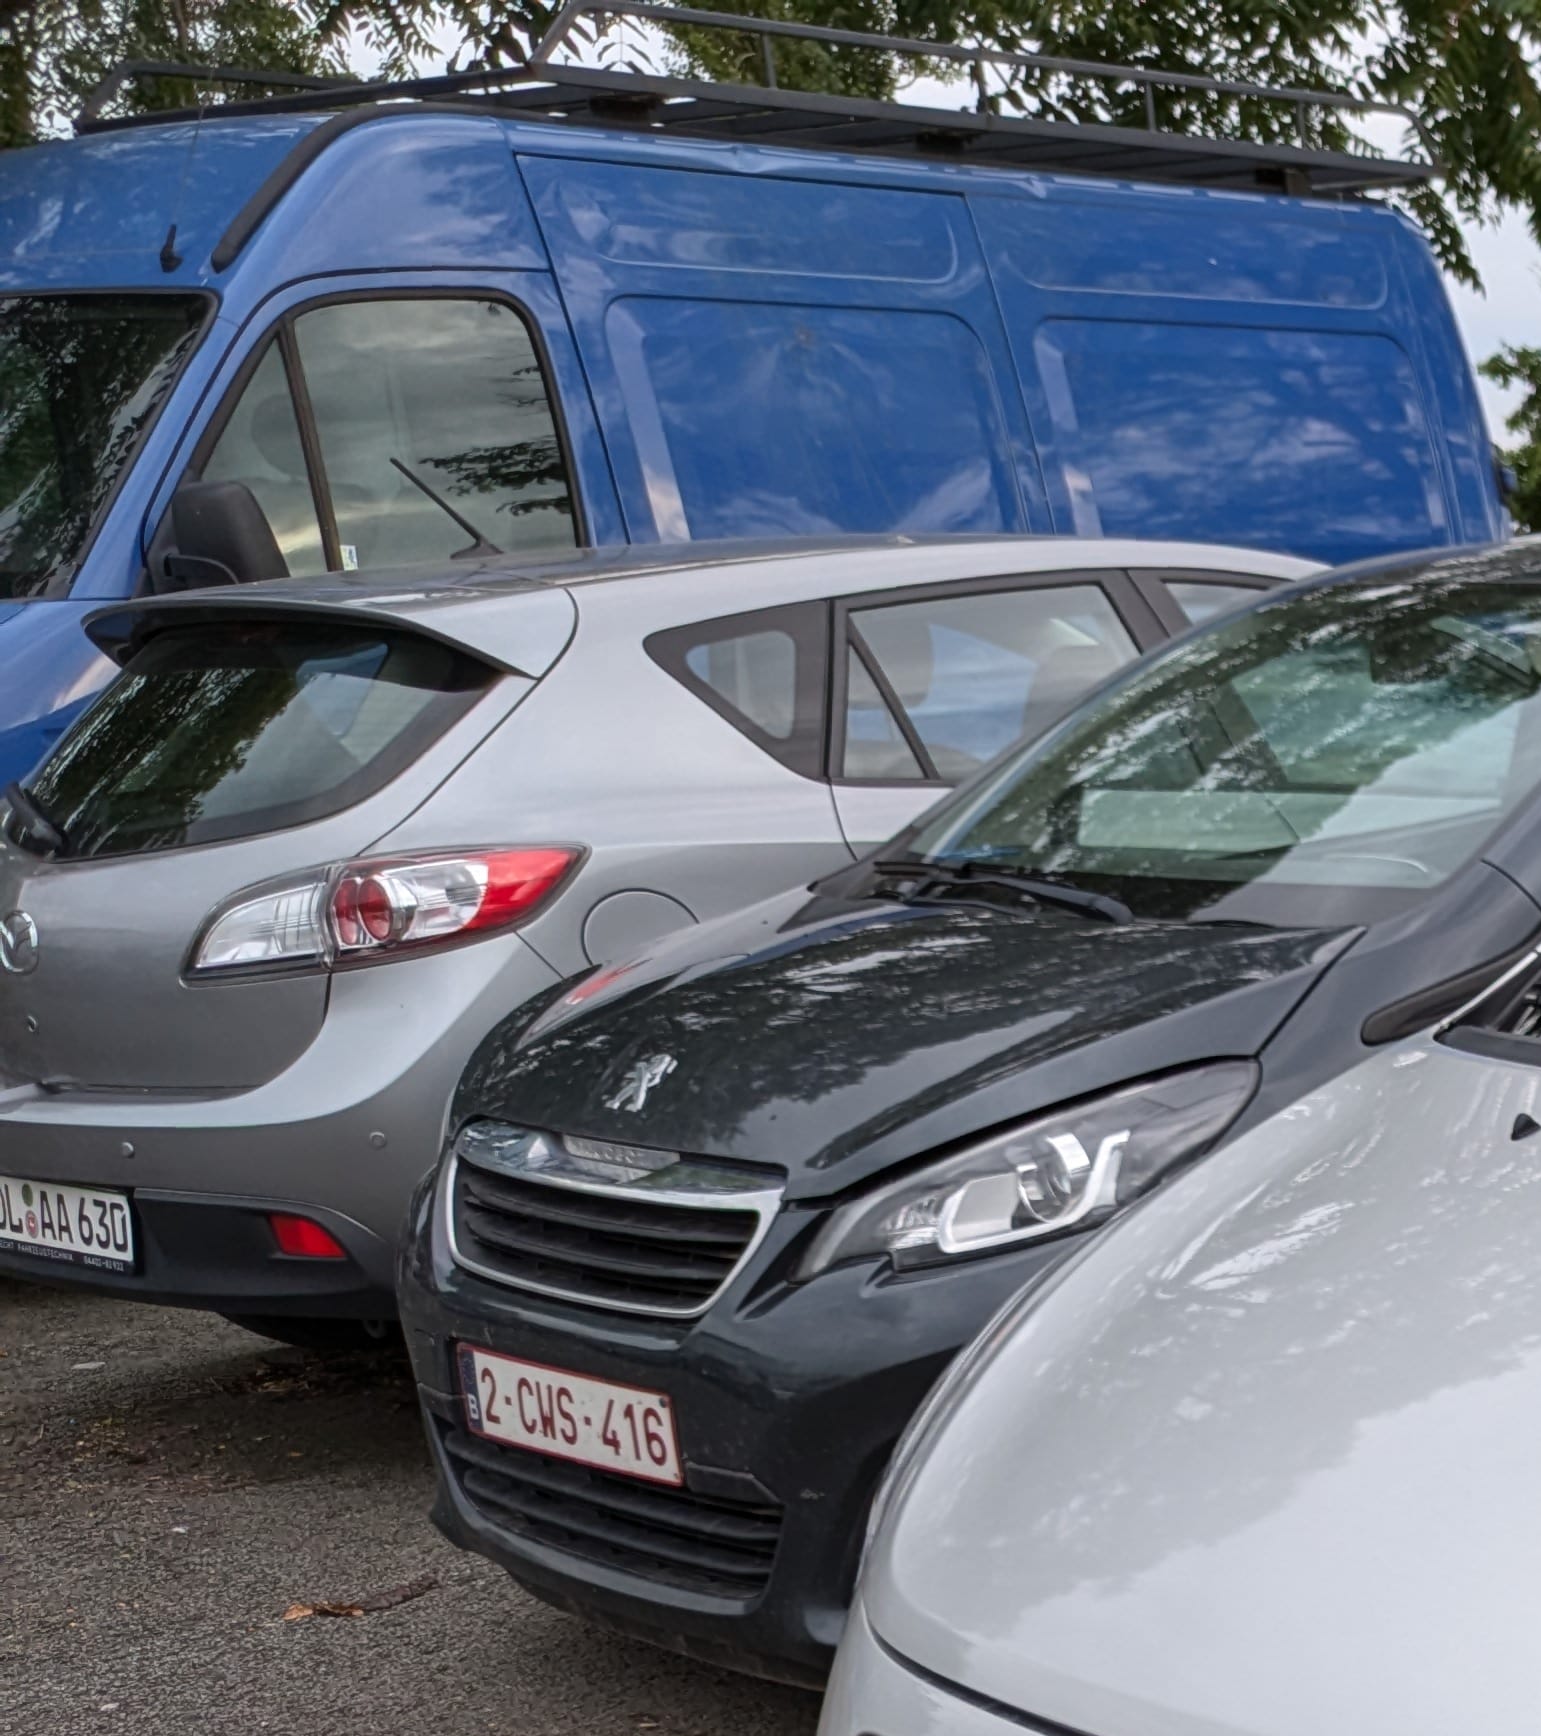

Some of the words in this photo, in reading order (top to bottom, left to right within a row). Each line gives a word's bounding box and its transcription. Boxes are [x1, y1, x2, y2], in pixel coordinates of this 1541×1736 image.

[40, 1190, 74, 1244] AA
[79, 1197, 128, 1252] 630
[466, 1393, 480, 1421] B
[481, 1367, 667, 1466] 2-CWS-416
